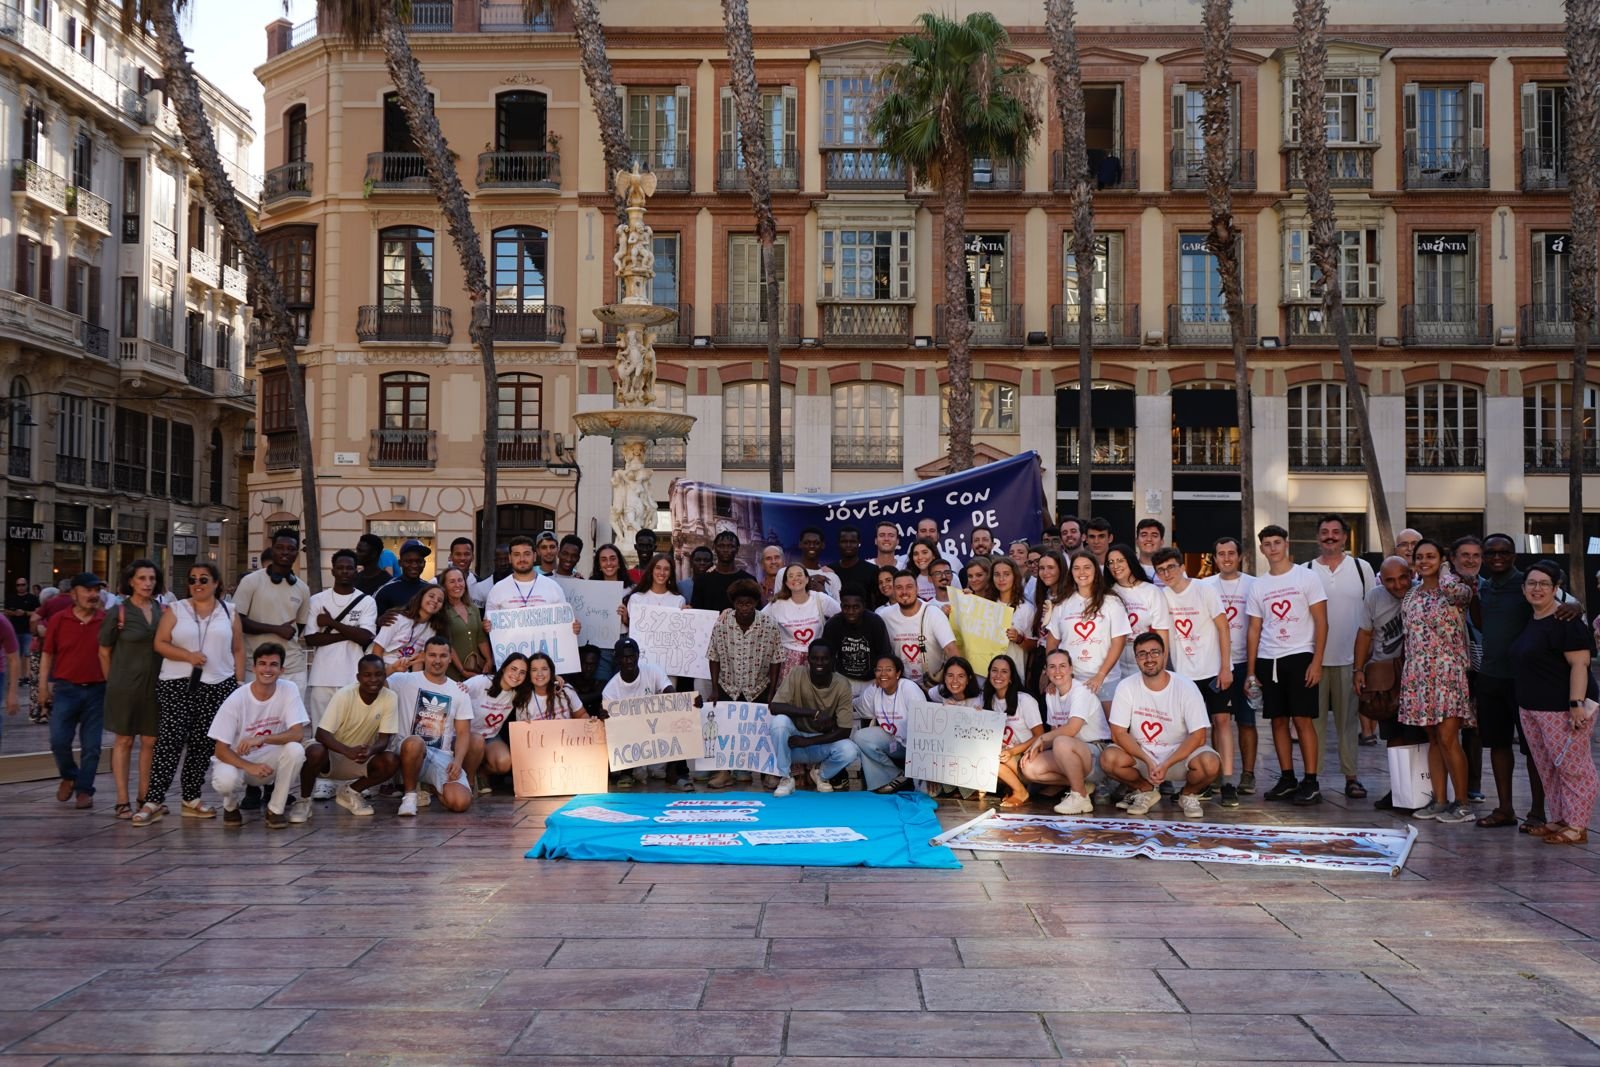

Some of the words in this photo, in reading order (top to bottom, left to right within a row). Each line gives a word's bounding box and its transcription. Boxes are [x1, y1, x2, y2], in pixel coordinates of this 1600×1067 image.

[945, 488, 991, 505] CON
[971, 509, 1000, 528] DE
[727, 703, 768, 722] POR
[646, 717, 659, 735] Y
[737, 722, 771, 736] UNA
[613, 736, 683, 766] ACOGIDA
[717, 735, 772, 753] VIDA
